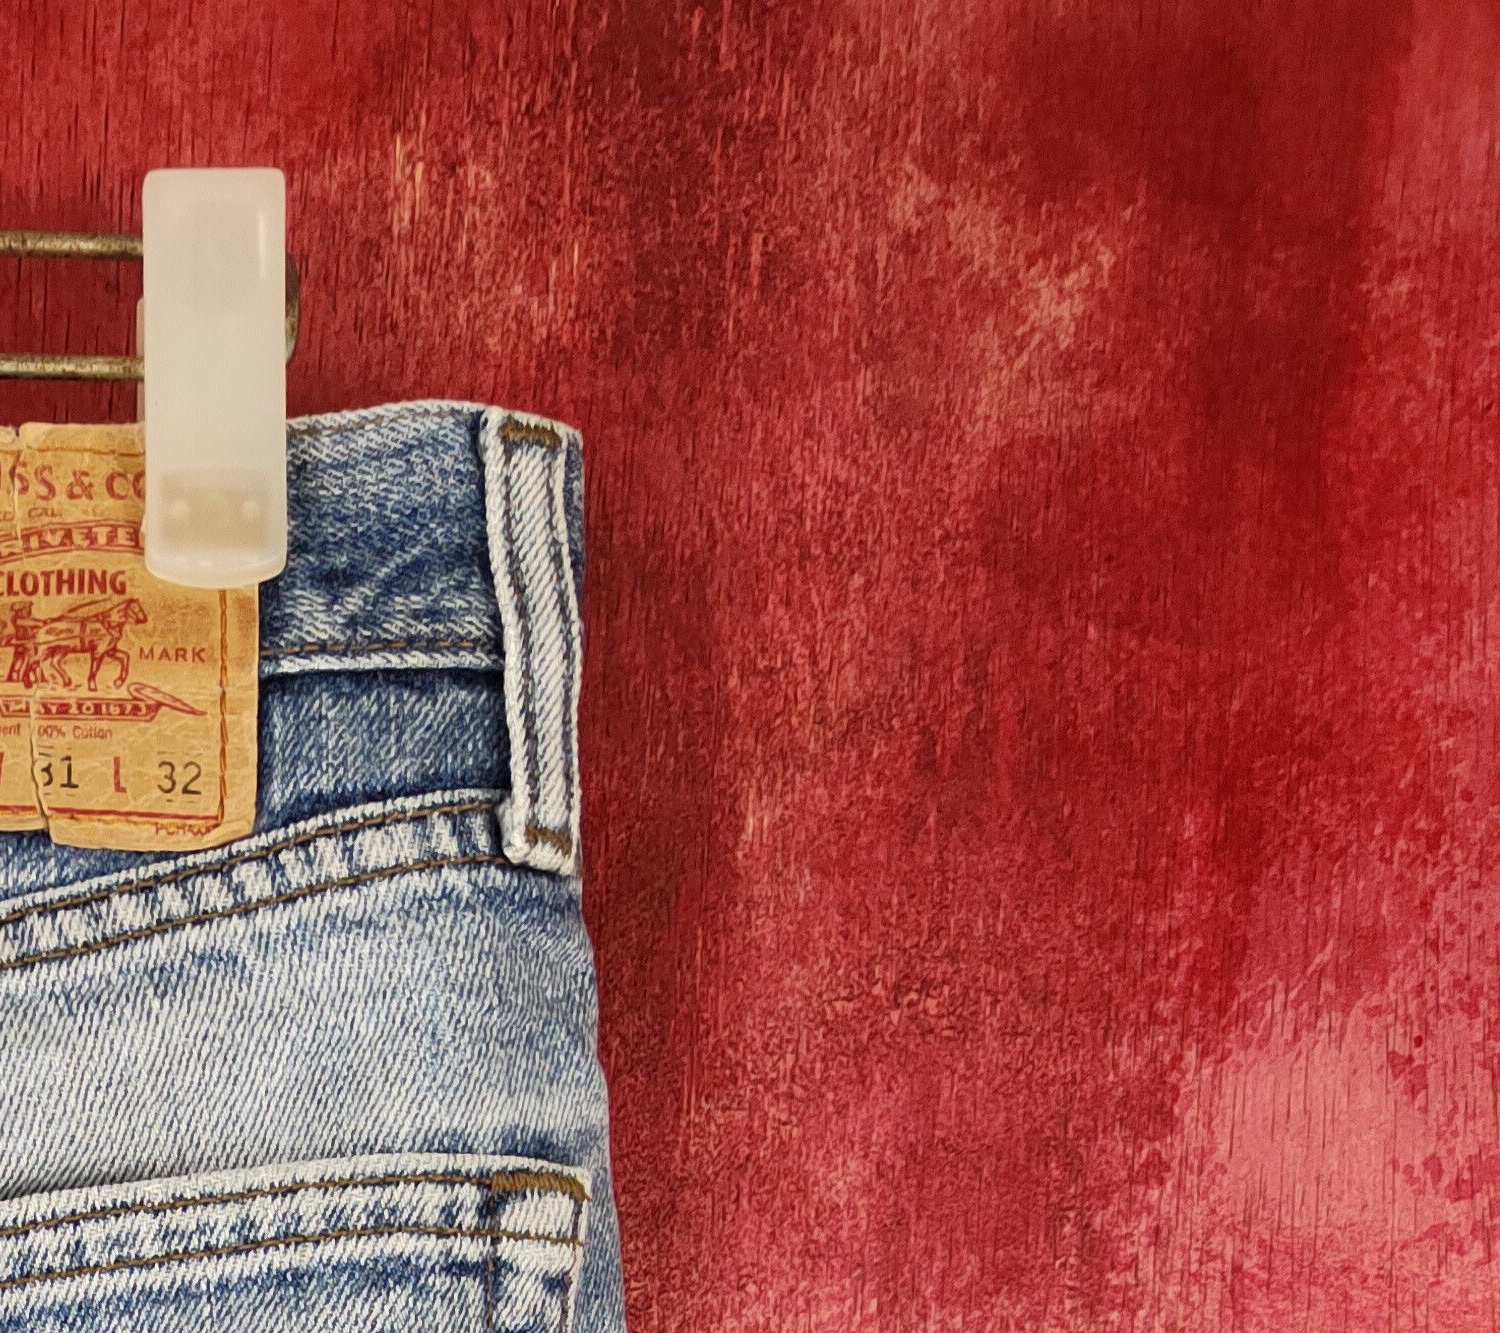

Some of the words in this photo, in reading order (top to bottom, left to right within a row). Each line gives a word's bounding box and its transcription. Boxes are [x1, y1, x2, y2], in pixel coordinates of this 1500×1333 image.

[65, 469, 95, 500] &
[138, 646, 207, 664] MARK
[113, 756, 127, 793] L
[157, 760, 202, 795] 32
